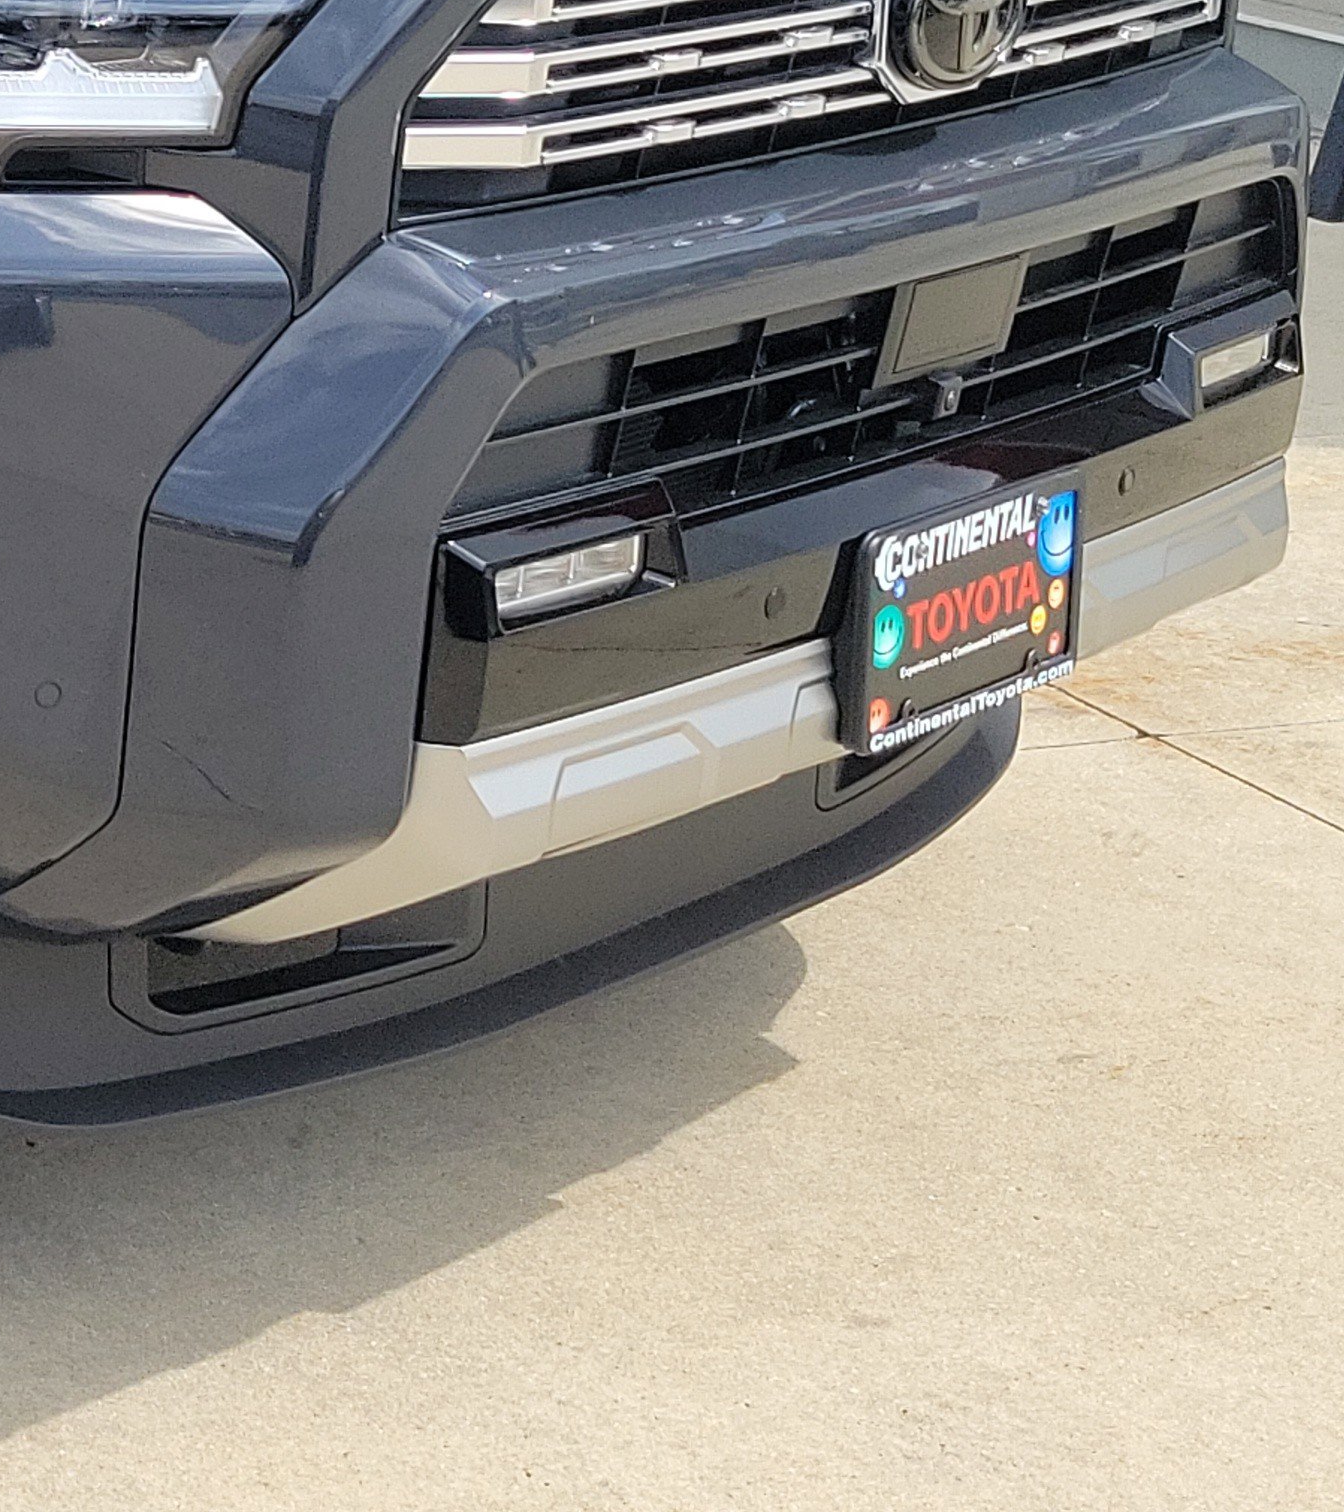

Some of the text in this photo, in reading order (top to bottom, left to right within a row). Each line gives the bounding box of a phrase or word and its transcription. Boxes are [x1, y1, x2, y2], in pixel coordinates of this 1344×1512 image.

[874, 492, 1036, 591] CONTINENTAL
[906, 561, 1040, 650] TOYOTA
[869, 660, 1074, 753] ContinentalToyota.com
